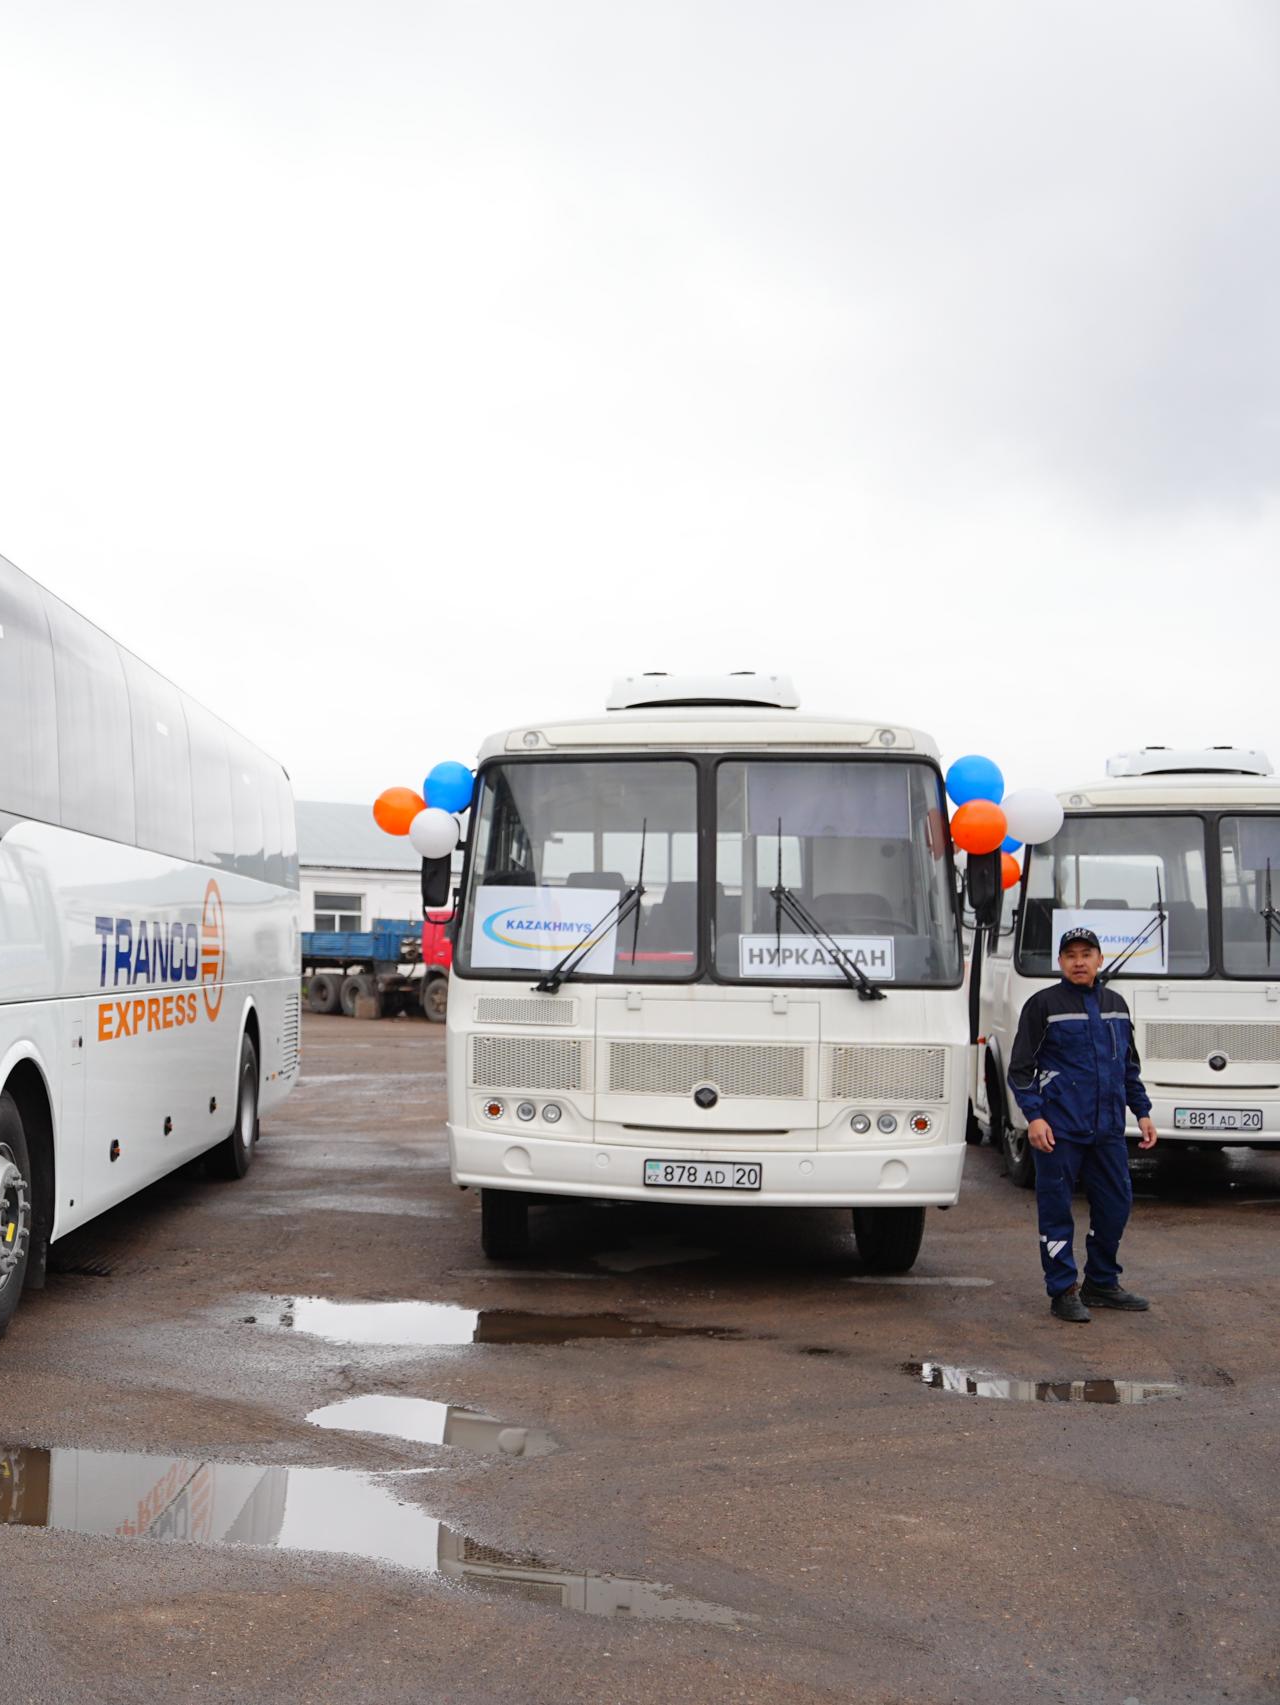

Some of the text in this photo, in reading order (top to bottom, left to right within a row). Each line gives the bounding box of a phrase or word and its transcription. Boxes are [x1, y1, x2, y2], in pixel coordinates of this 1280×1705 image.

[506, 920, 592, 933] KAZAKHMYS
[1096, 935, 1149, 944] ZAKHMYS
[95, 917, 198, 987] TRANCO
[748, 948, 886, 967] НУРКАЗГАН
[97, 992, 197, 1041] EXPRESS
[1189, 1112, 1215, 1125] 881
[1220, 1115, 1236, 1126] AD
[1243, 1113, 1260, 1126] 20
[647, 1165, 758, 1185] KZ 878 AD 20
